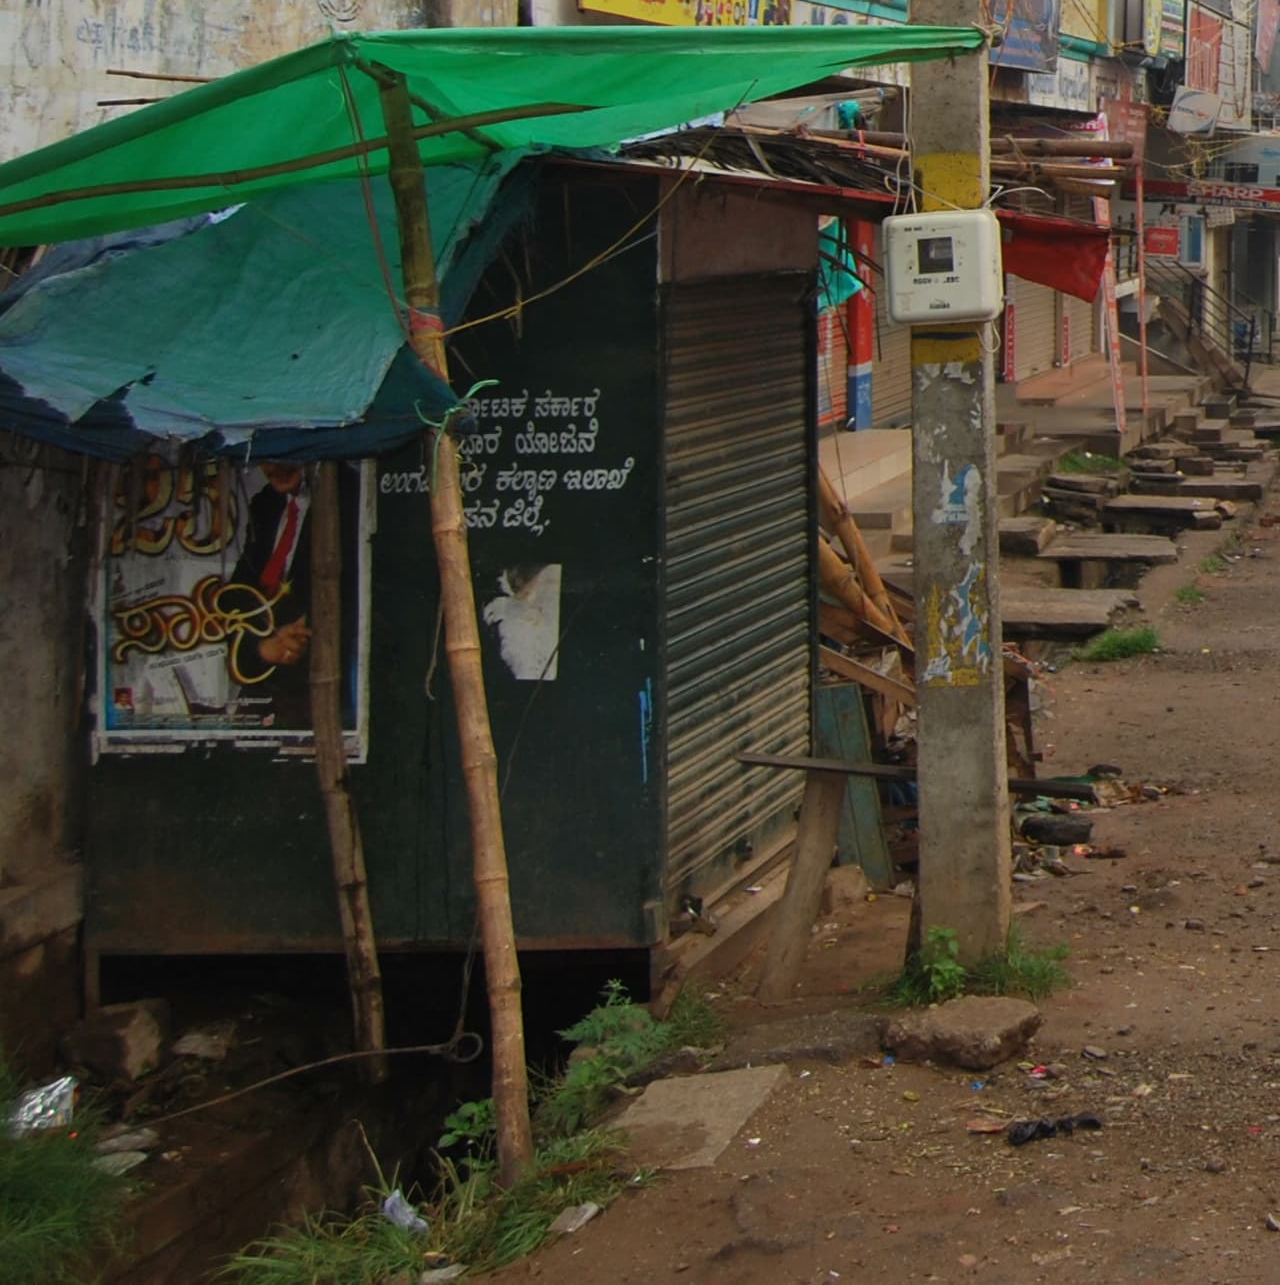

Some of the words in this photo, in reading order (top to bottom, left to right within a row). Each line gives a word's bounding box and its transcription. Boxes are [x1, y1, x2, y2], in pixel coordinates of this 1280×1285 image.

[1188, 182, 1264, 200] SHARP
[534, 388, 601, 418] ಸರ್ಕಾರ
[515, 419, 600, 455] ಯೋಜನೆ
[562, 456, 635, 490] ಇಲಾಖೆ
